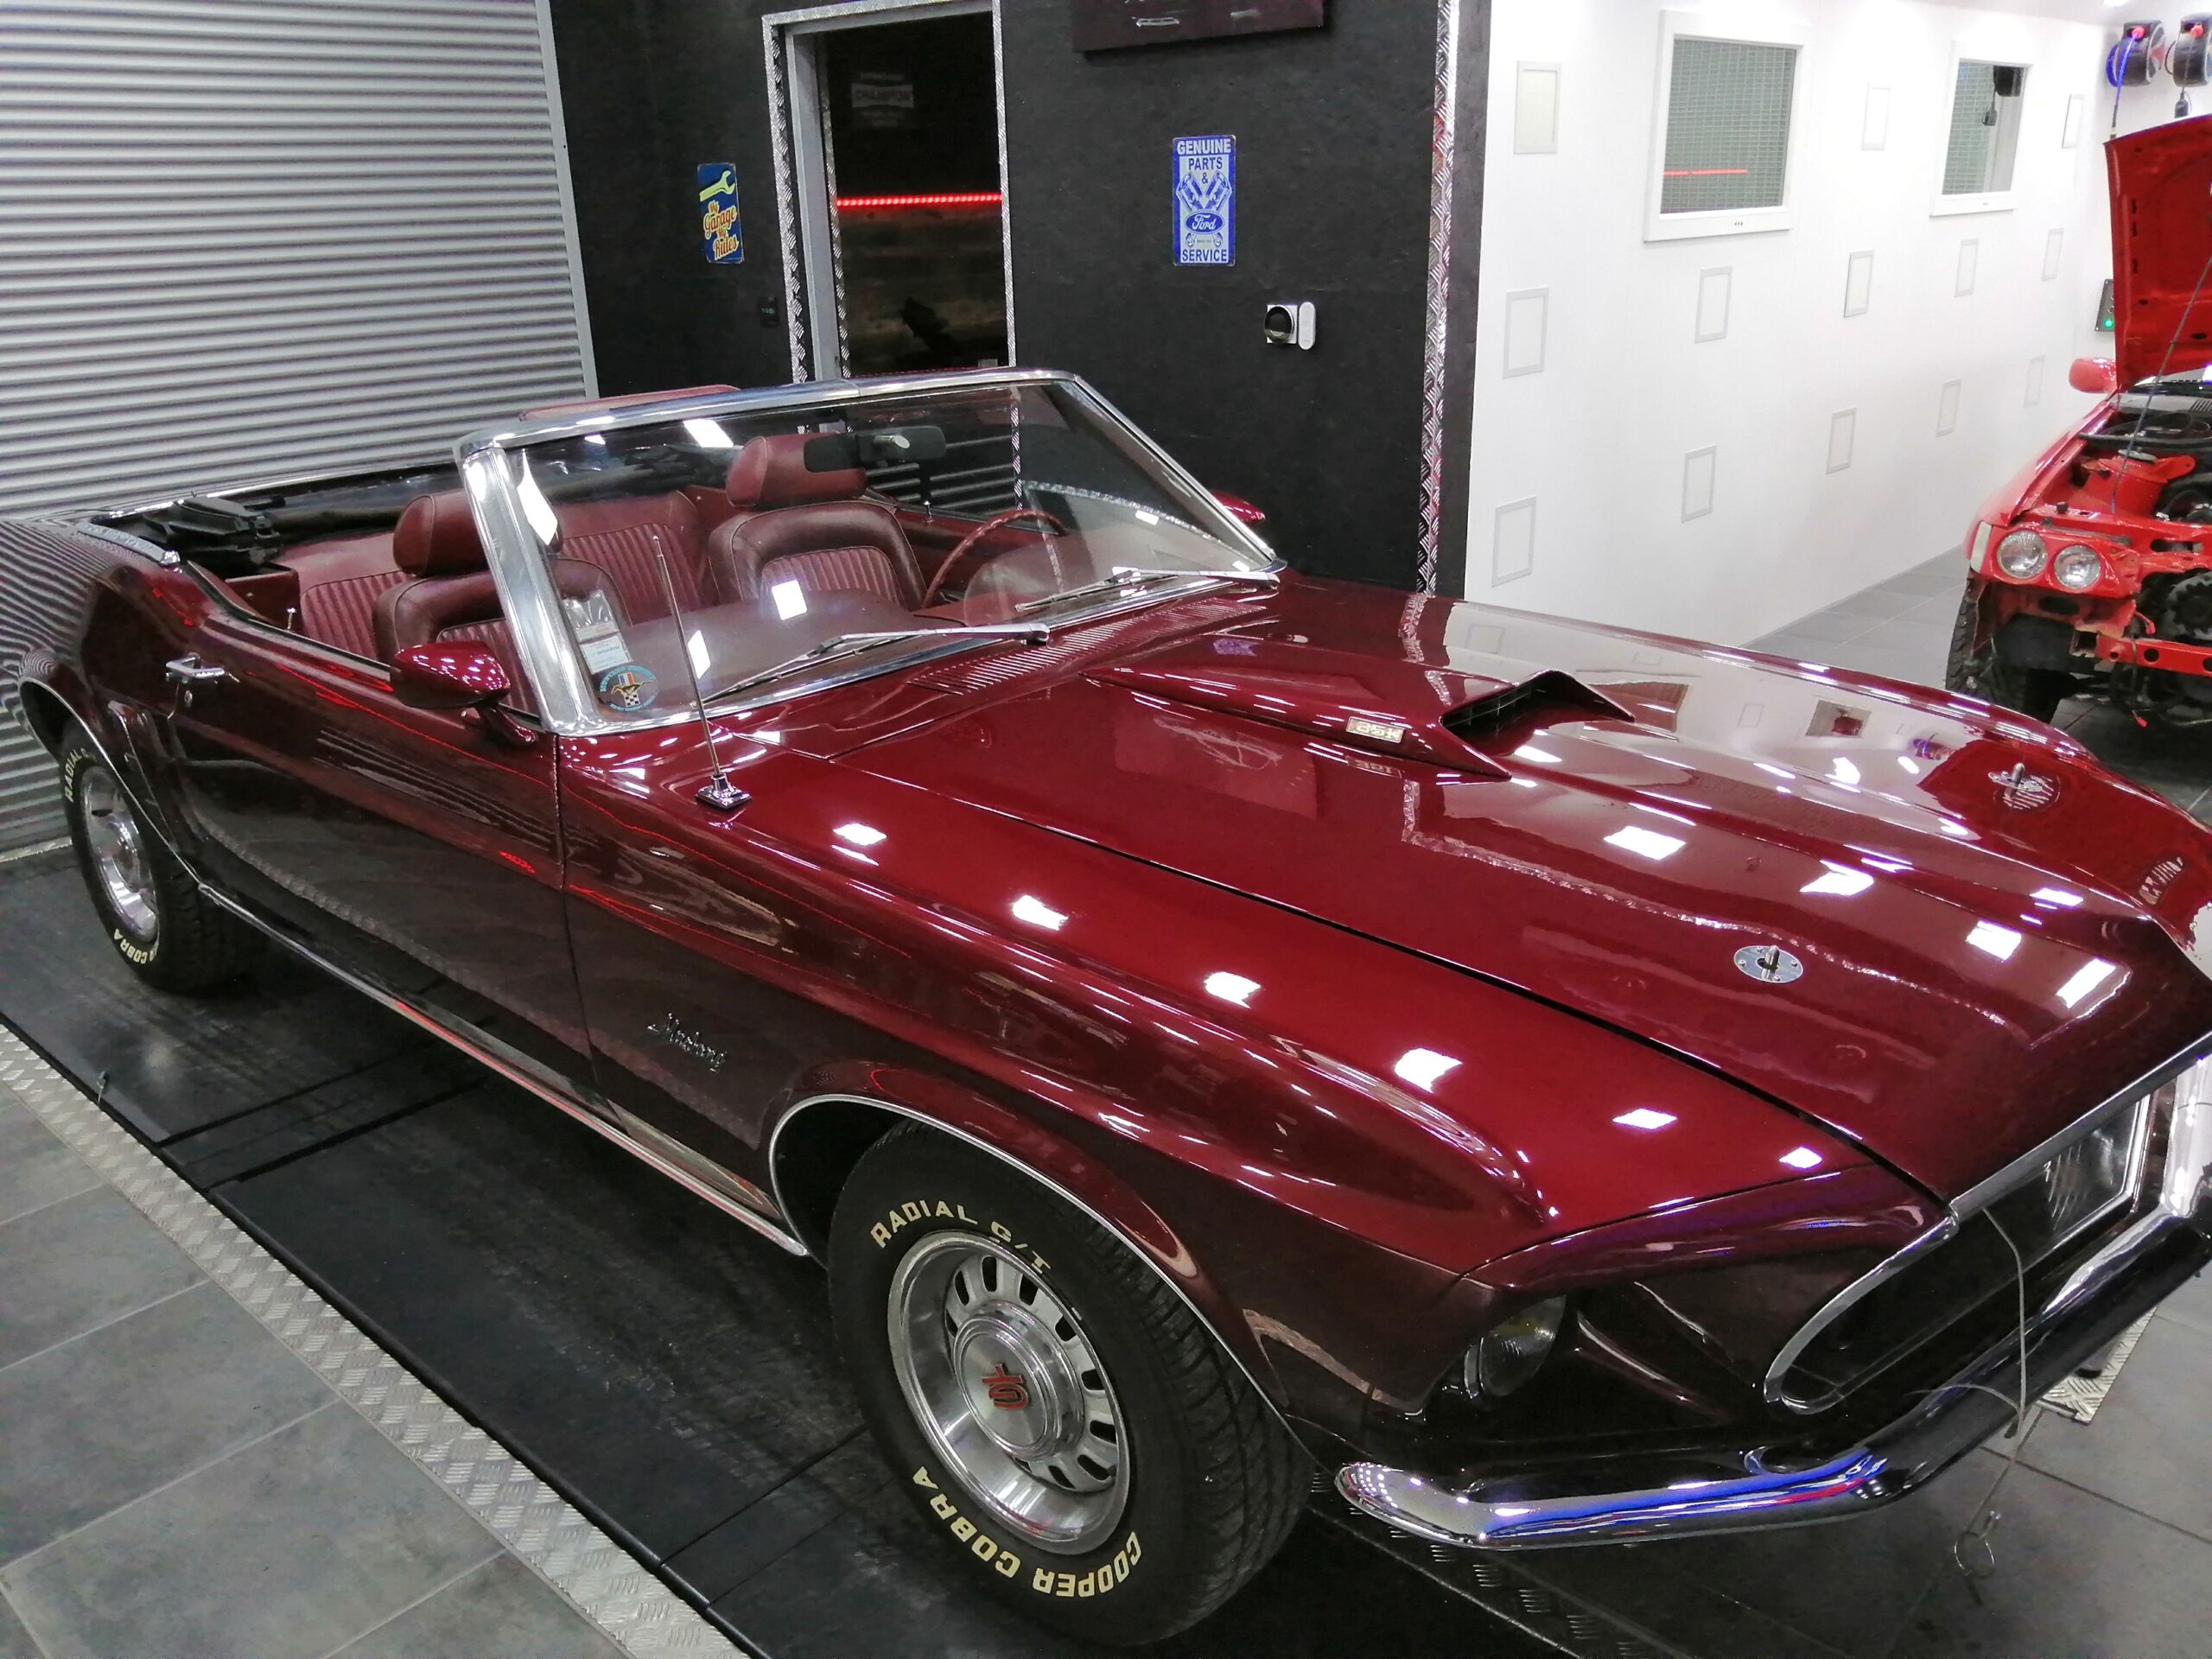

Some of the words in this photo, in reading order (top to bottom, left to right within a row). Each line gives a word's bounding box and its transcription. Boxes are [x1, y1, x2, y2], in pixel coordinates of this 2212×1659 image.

[1177, 139, 1231, 155] GENUINE
[1189, 157, 1223, 170] PARTS
[1201, 172, 1208, 184] &
[704, 206, 737, 239] Garage
[1192, 214, 1217, 230] Ford
[714, 234, 739, 260] Rules
[1182, 249, 1227, 262] SERVICE
[65, 749, 82, 803] RADIAL
[114, 928, 148, 963] COBRA
[870, 1200, 978, 1249] RADIAL
[912, 1466, 1020, 1578] COBRA
[1032, 1532, 1141, 1597] COOPER
